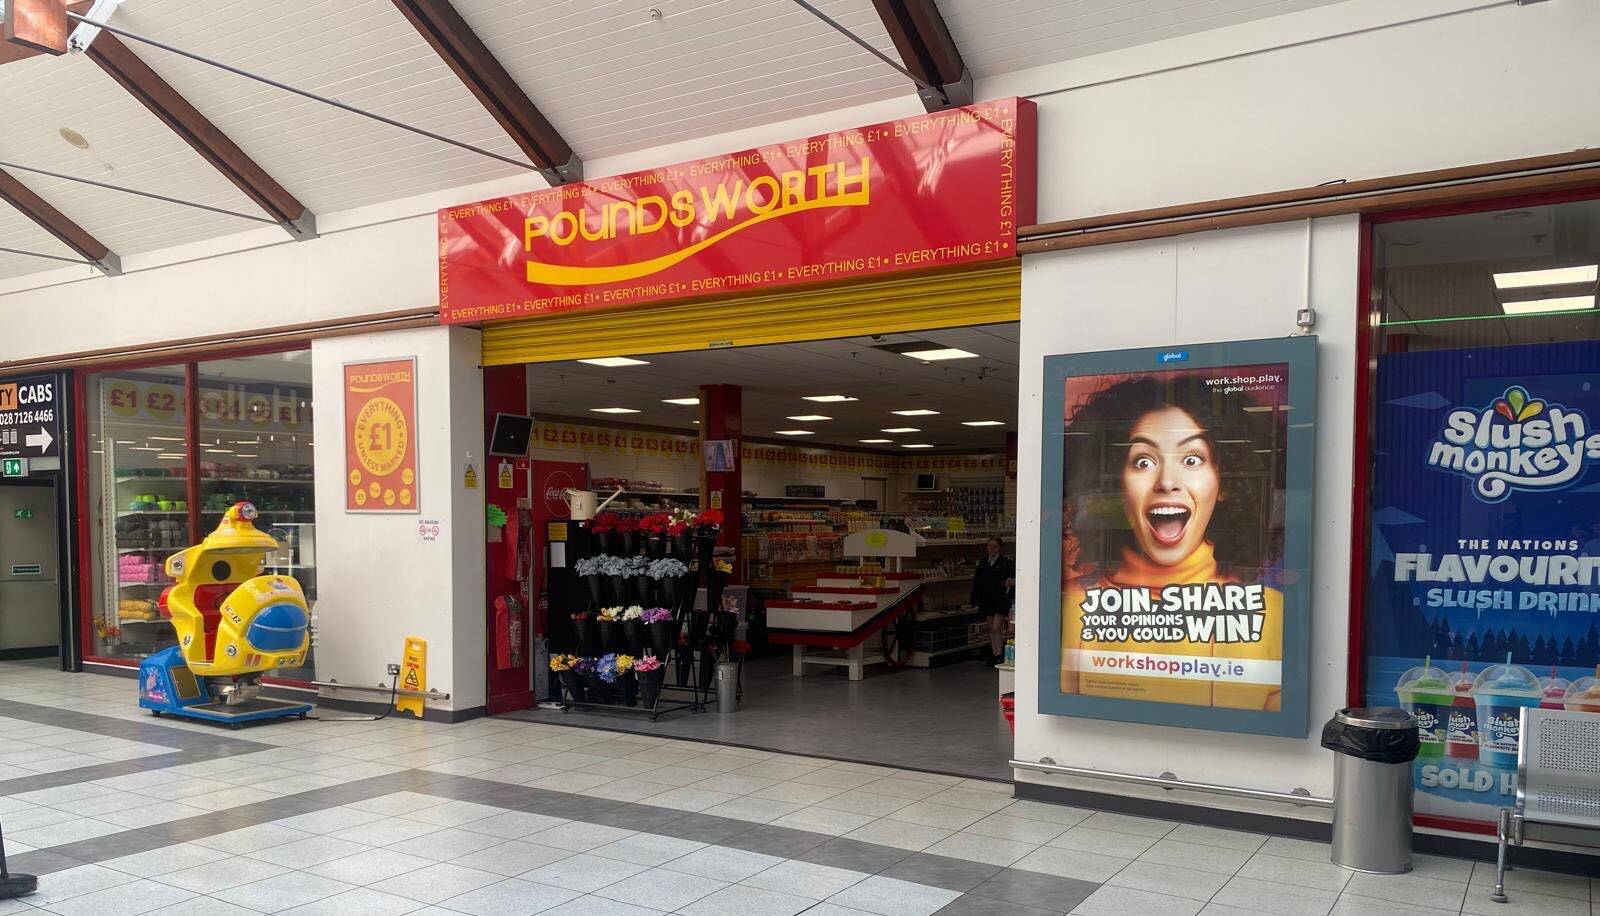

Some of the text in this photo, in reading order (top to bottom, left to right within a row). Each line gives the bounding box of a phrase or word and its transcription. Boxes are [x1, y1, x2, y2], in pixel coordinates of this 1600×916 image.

[449, 203, 502, 221] EVERYTHING
[521, 188, 578, 207] EVERYTHING
[602, 172, 664, 193] EVERYTHING
[691, 153, 760, 177] EVERYTHING
[787, 133, 864, 158] EVERYTHING
[867, 129, 881, 142] £1
[894, 110, 981, 138] EVERYTHING
[985, 106, 1000, 120] £1
[1000, 118, 1013, 237] EVERYTHING £1
[441, 237, 449, 309] EVERYTHING
[452, 240, 1000, 320] EVERYTHING £1 EVERYTHING £1 EVERYTHING £1 EVERYTHING £1 EVERYTHING £1 EVERYTHING £1
[1163, 352, 1182, 362] global
[19, 383, 53, 405] CABS
[110, 388, 137, 408] £1
[146, 391, 176, 412] £2
[1224, 385, 1243, 395] global
[1244, 384, 1275, 393] audience
[14, 411, 33, 424] 7126
[34, 409, 53, 423] 4466
[358, 400, 405, 431] EVERYTHING
[1443, 409, 1586, 450] Slush
[369, 422, 392, 451] £1
[544, 428, 559, 442] £2
[562, 430, 576, 443] £3
[580, 432, 594, 444] £4
[597, 433, 610, 446] £5
[615, 435, 626, 448] £1
[646, 438, 658, 451] £3
[358, 441, 404, 472] UNLESS MARKED
[1458, 539, 1579, 551] THE NATIONS
[1081, 584, 1263, 613] JOIN, SHARE
[1427, 588, 1513, 612] SLUSH
[1082, 613, 1184, 627] YOUR OPINIONS
[1082, 614, 1264, 642] & YOU COULD WIN!
[1092, 654, 1244, 678] workshopplay.ie
[1421, 764, 1494, 792] SOLD
